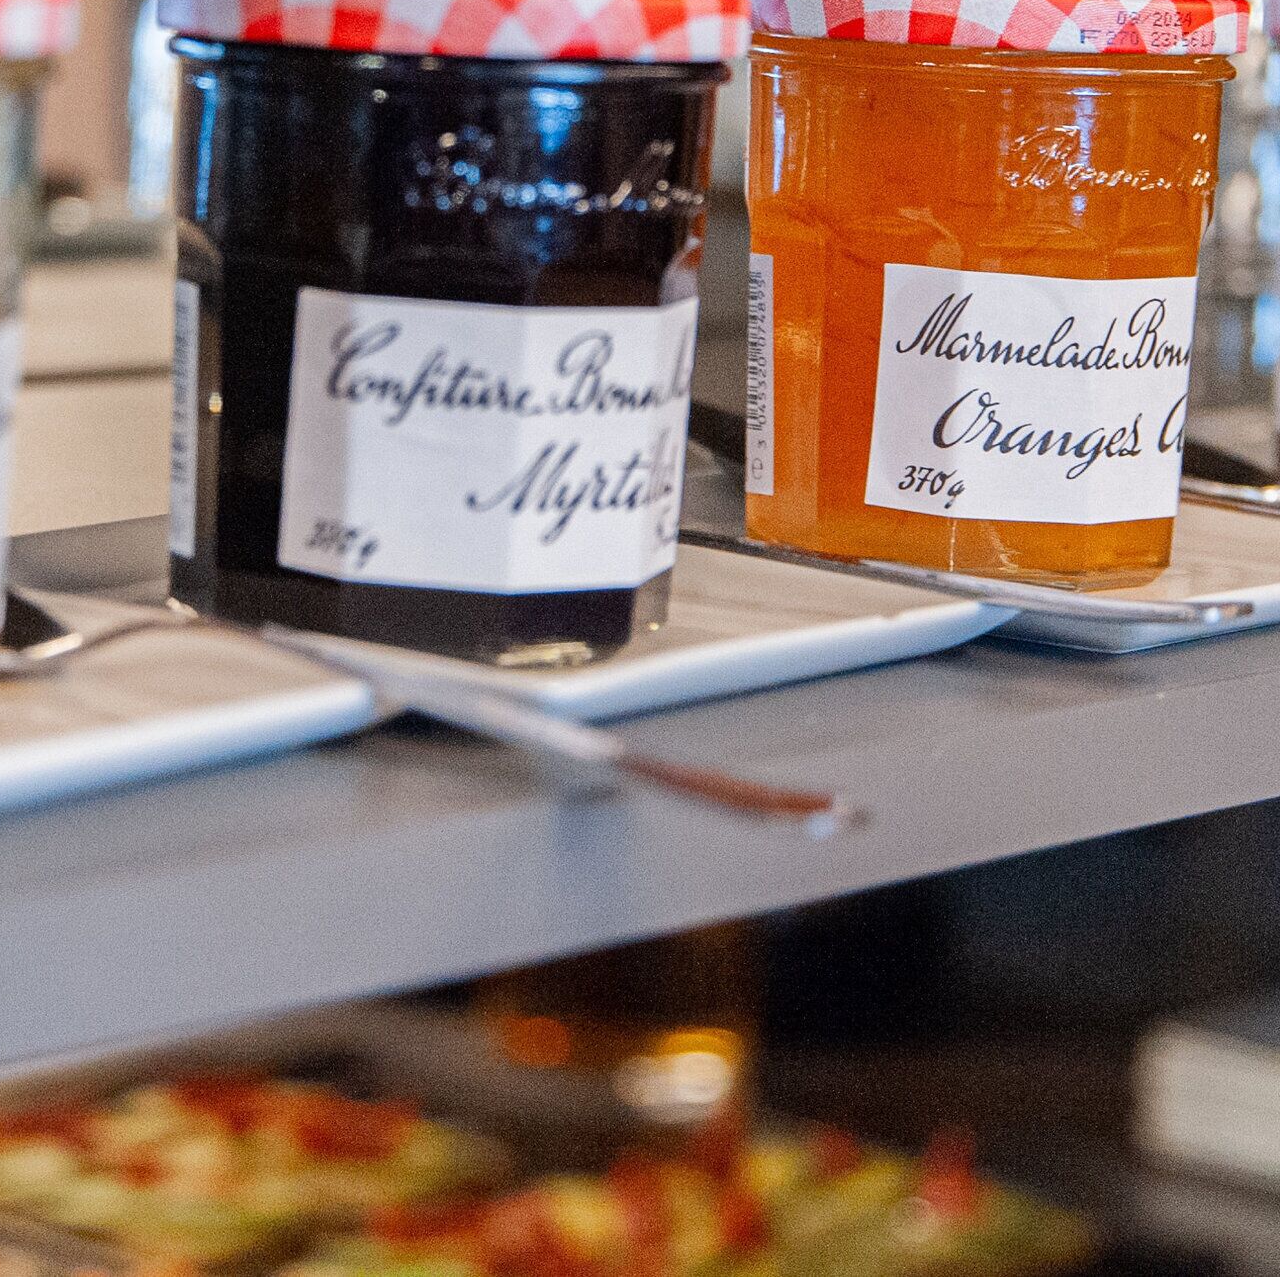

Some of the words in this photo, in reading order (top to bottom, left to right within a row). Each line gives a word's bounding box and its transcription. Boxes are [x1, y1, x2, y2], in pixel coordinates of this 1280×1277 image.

[326, 321, 544, 427] Confiture
[896, 293, 1119, 371] Marmelade
[932, 388, 1143, 480] Oranges
[897, 465, 966, 509] 370g
